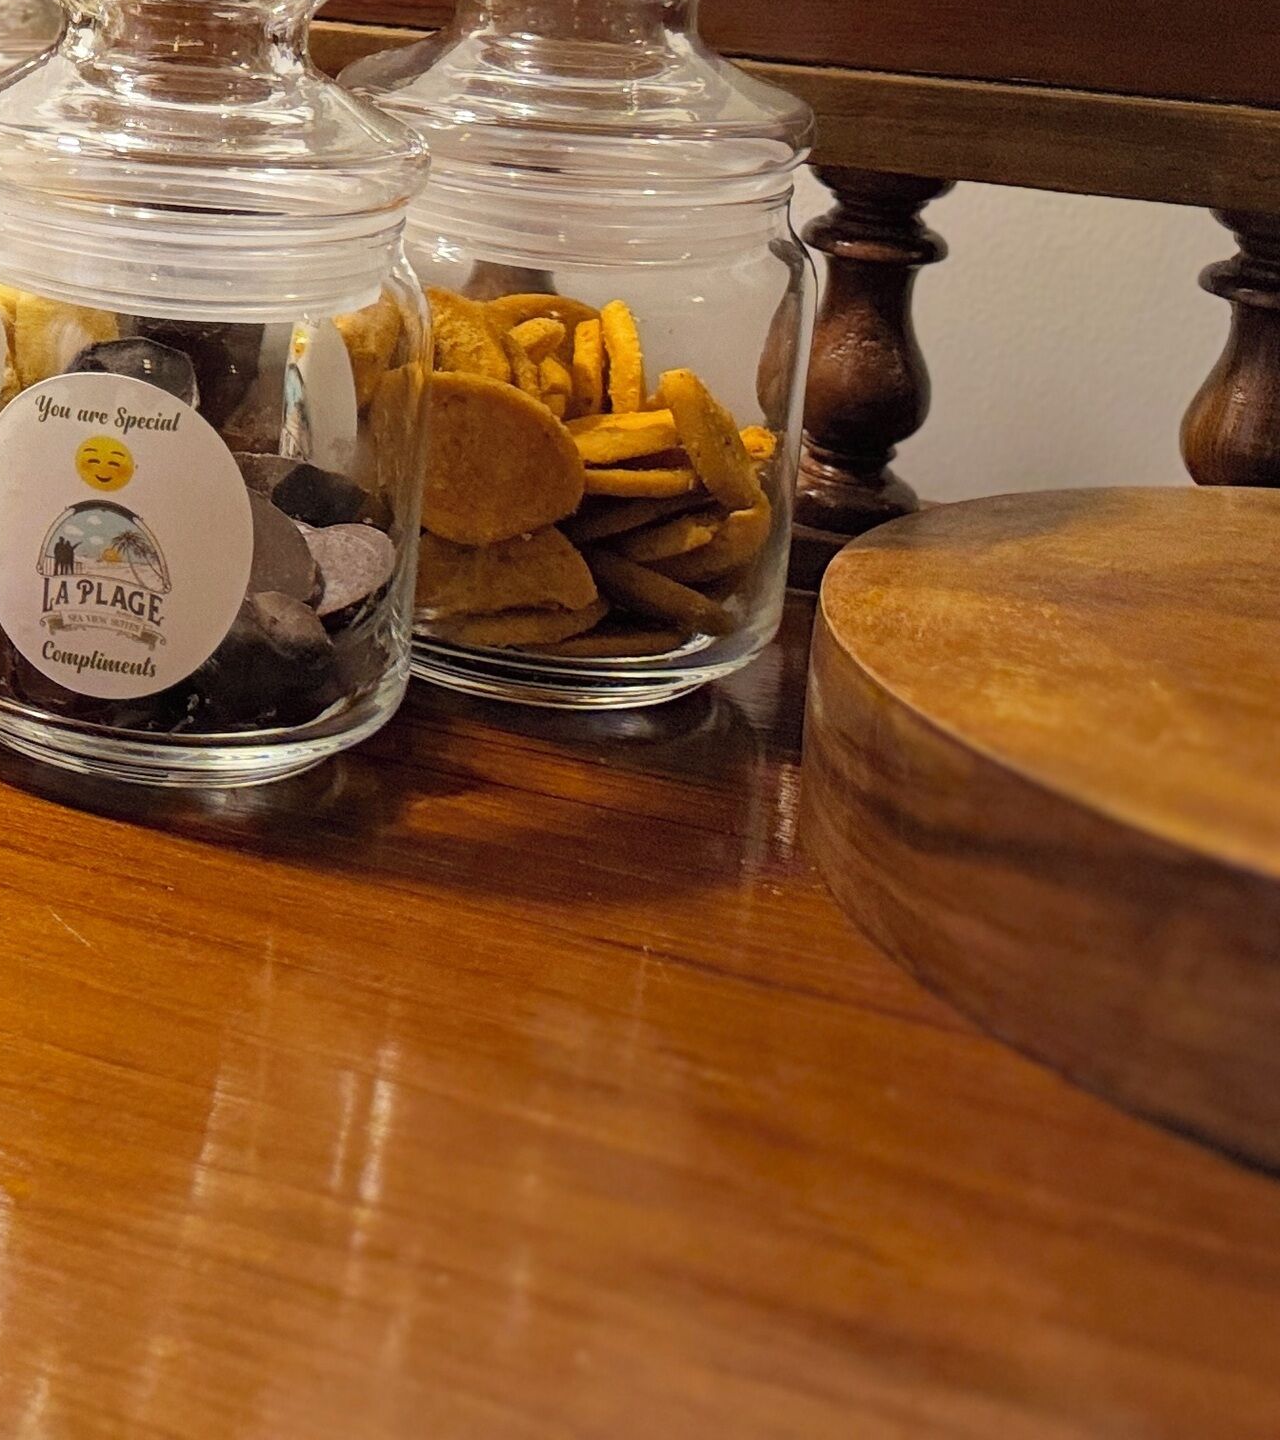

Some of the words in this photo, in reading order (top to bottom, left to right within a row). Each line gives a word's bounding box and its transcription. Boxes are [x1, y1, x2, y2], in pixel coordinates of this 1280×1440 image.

[35, 394, 71, 423] You
[77, 408, 108, 425] are
[114, 406, 182, 435] Special
[42, 577, 70, 613] LA
[76, 578, 165, 627] PLAGE
[42, 640, 157, 678] Compliments
